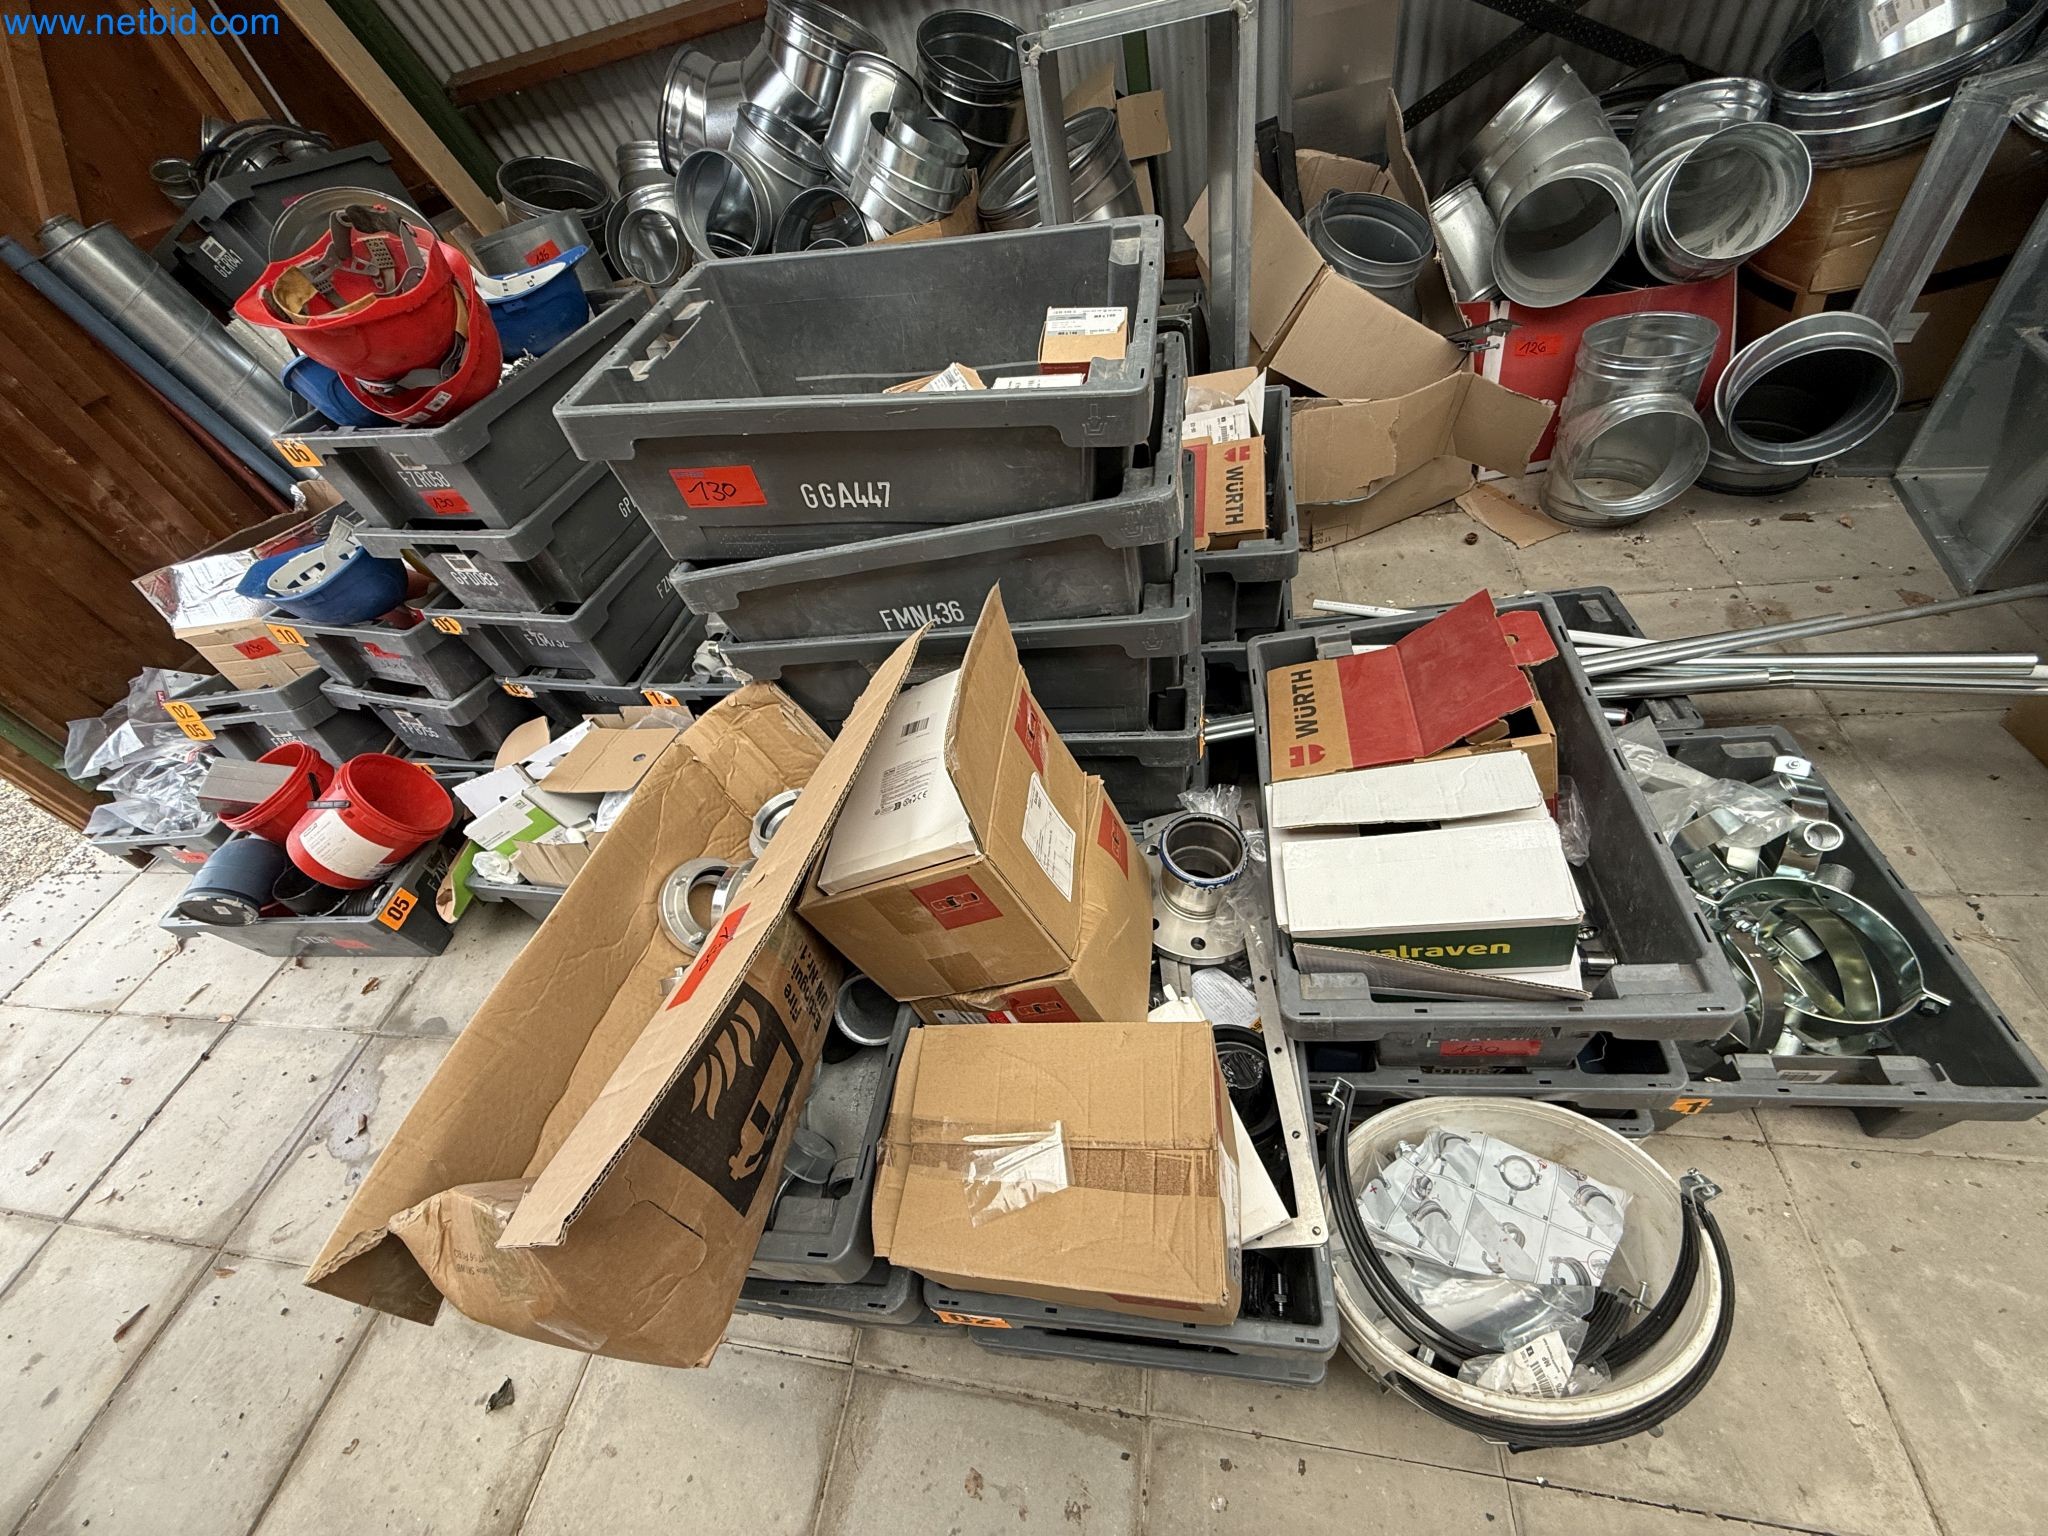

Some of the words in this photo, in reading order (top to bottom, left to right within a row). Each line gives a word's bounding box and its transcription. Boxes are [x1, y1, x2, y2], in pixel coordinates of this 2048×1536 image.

[1519, 341, 1546, 355] 126
[688, 481, 736, 501] 130
[800, 481, 891, 509] GGA447
[618, 497, 636, 518] GP
[879, 601, 965, 631] FMN436
[275, 628, 297, 645] 10
[171, 705, 195, 719] 02
[185, 724, 207, 737] 05
[387, 896, 410, 921] 05
[783, 982, 802, 1024] Fire
[790, 957, 822, 1033] Extingui
